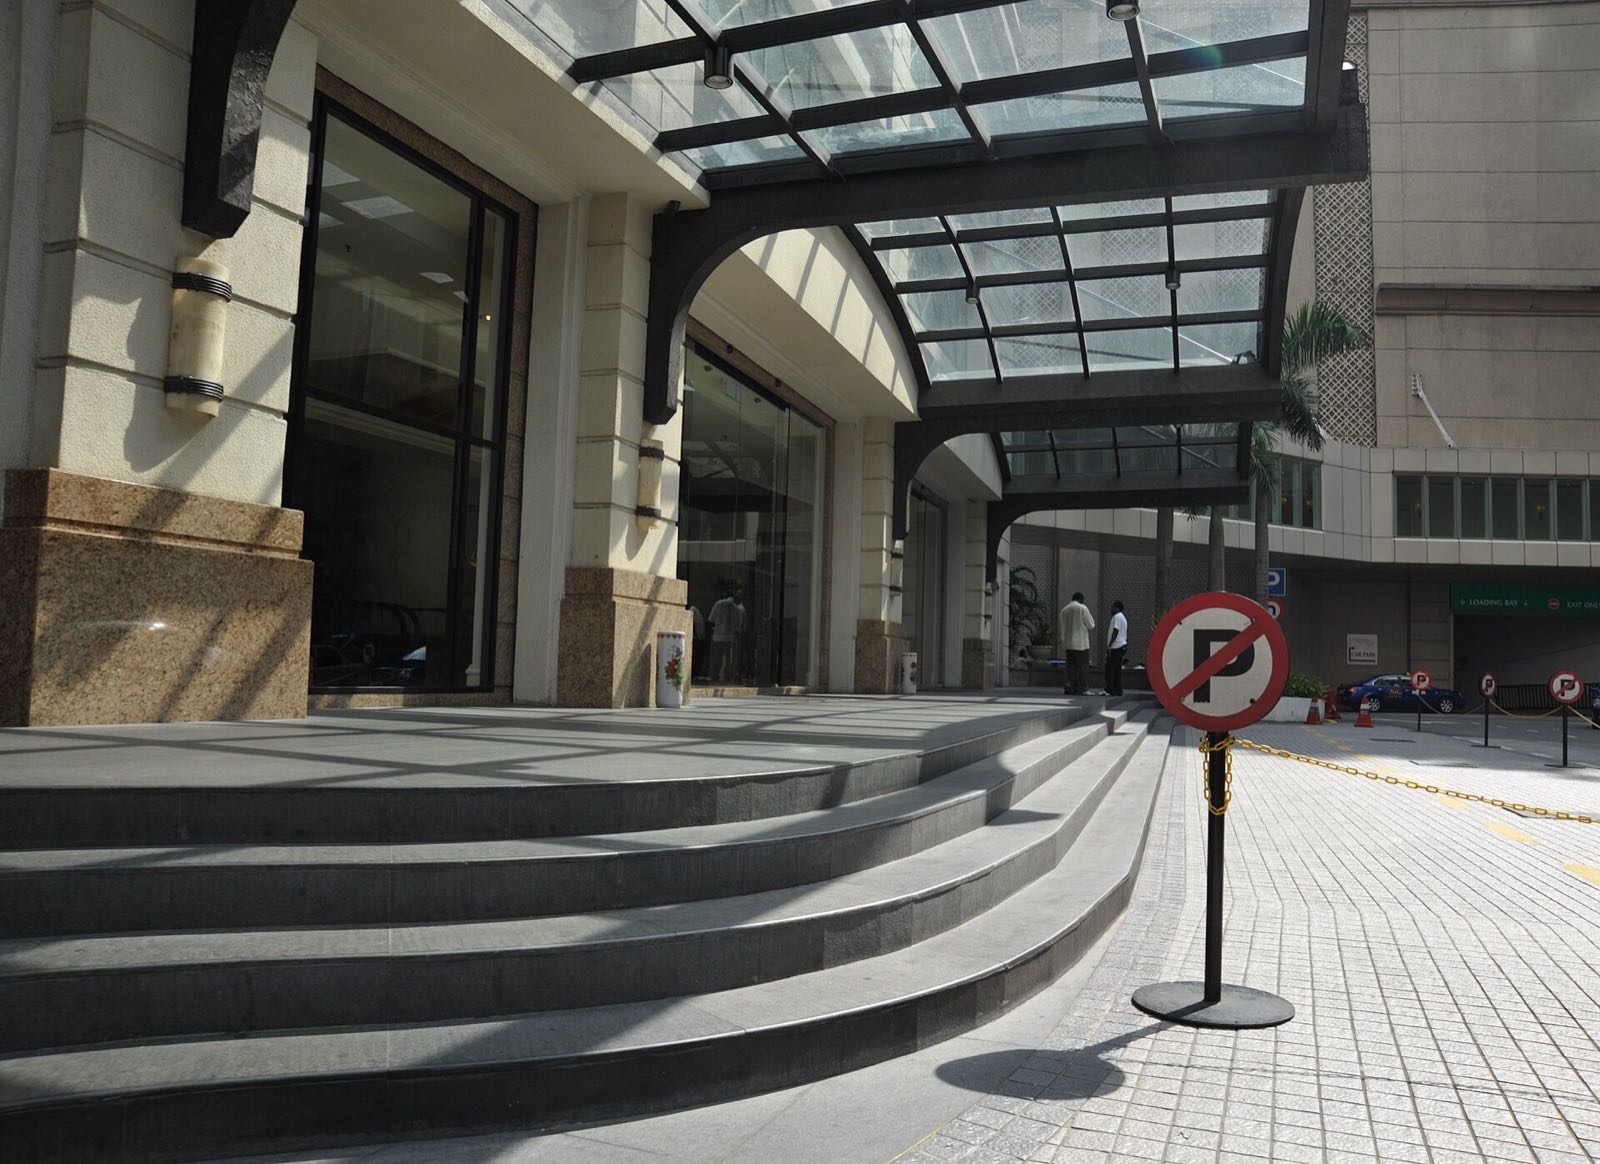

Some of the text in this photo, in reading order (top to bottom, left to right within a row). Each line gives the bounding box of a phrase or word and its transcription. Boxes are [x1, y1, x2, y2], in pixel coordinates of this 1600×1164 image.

[1504, 599, 1519, 607] BAY
[1193, 629, 1255, 703] P
[1560, 679, 1575, 697] P
